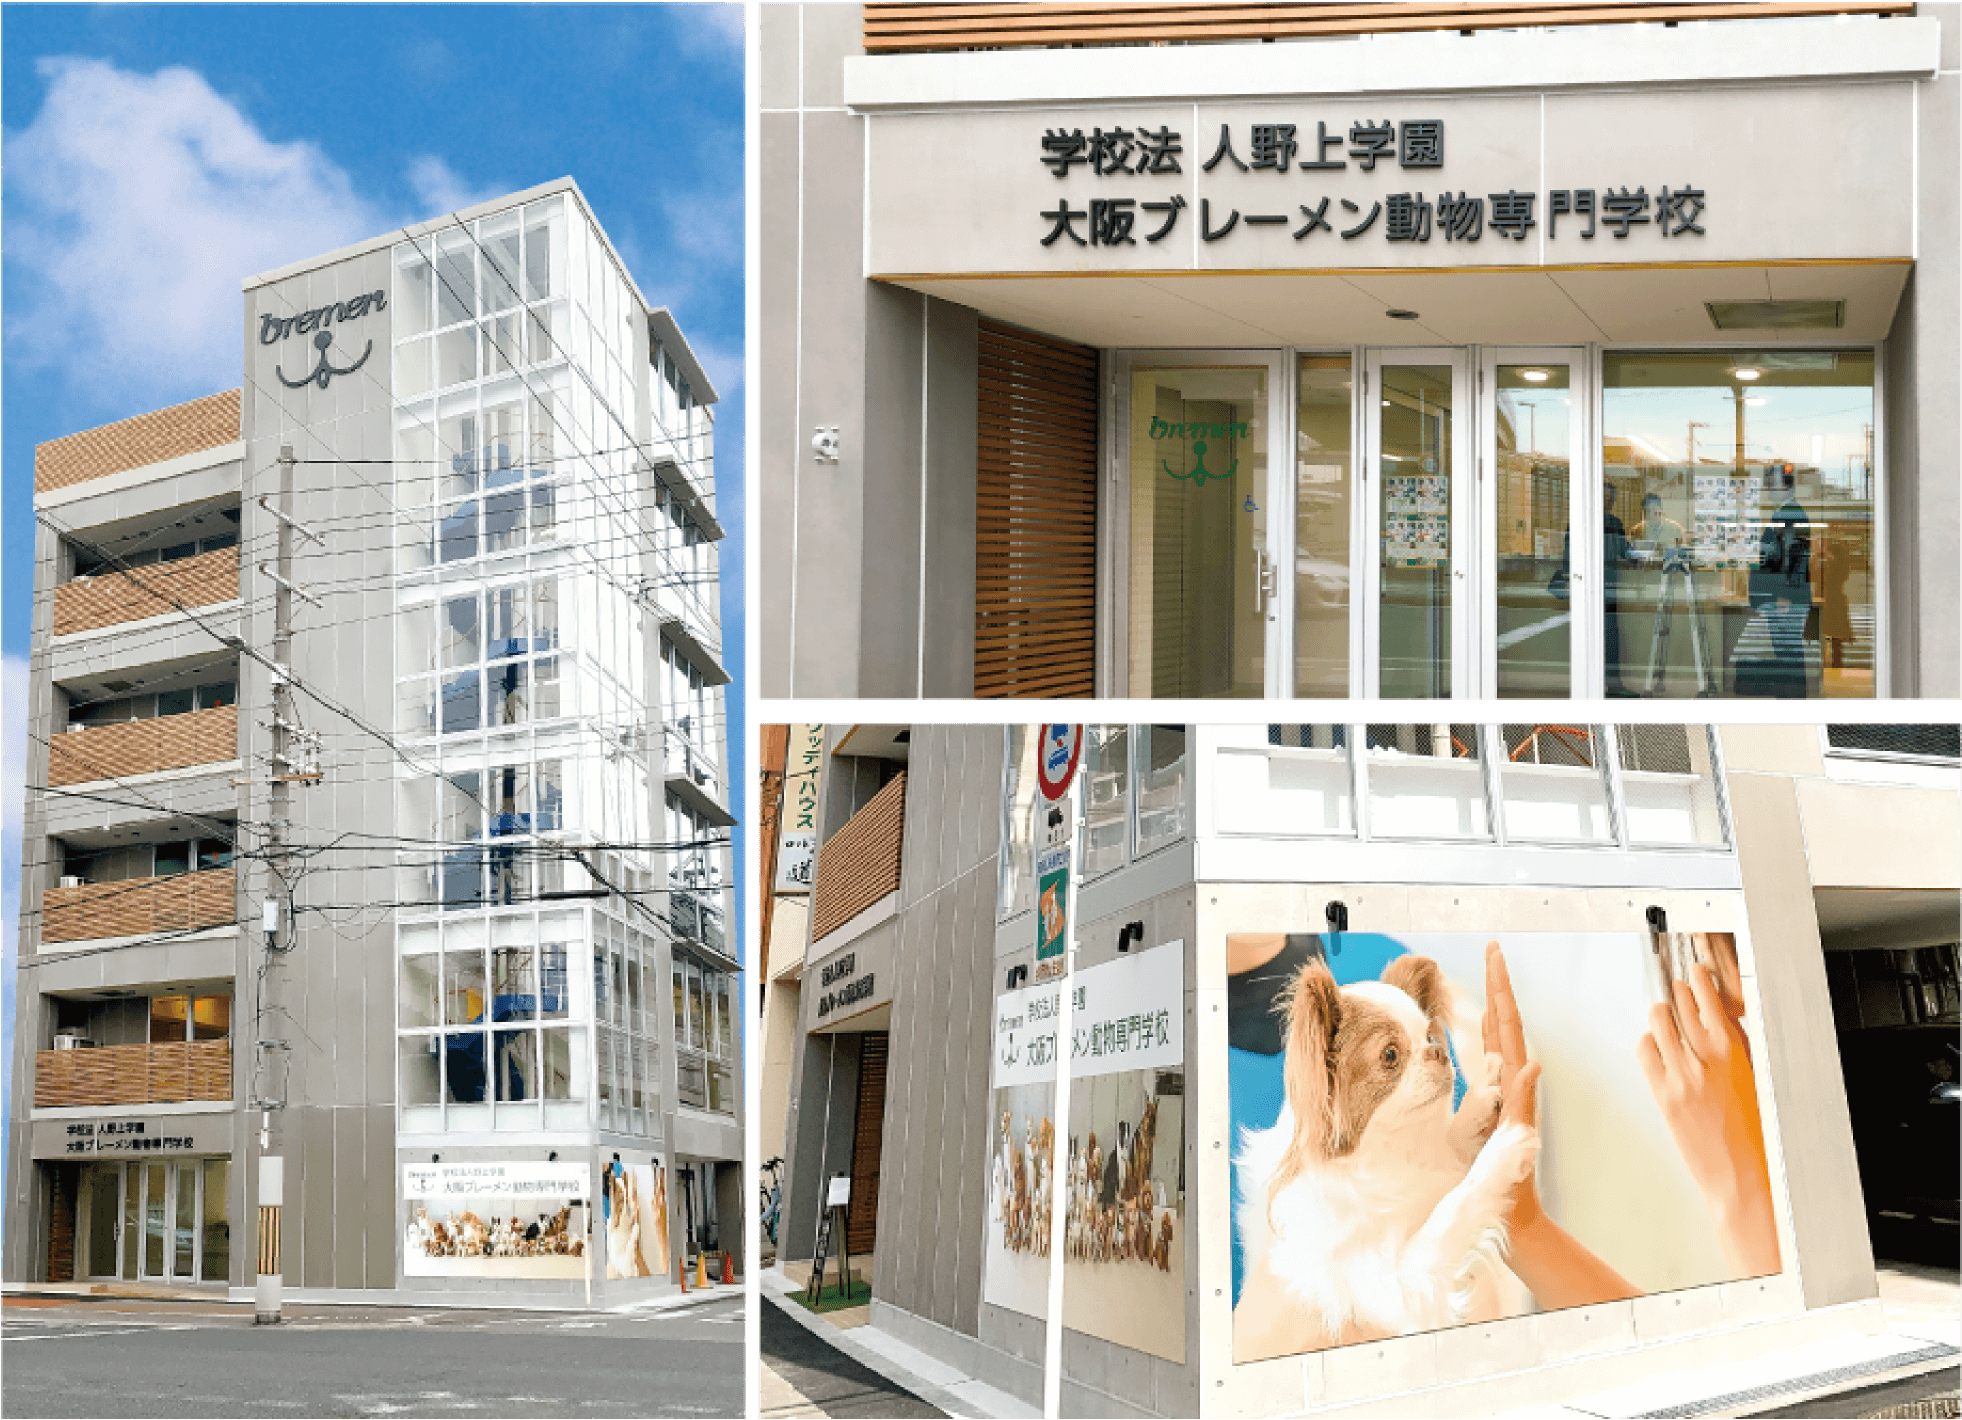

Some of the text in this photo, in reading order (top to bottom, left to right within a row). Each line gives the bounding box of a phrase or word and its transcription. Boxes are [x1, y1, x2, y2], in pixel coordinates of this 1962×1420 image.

[1040, 119, 1444, 177] 学校法人野上学園
[1040, 184, 1706, 247] 大阪ブレーメン動物専門学校
[259, 289, 388, 345] bremen
[1026, 1008, 1171, 1068] 大阪ブメン動物専門学校
